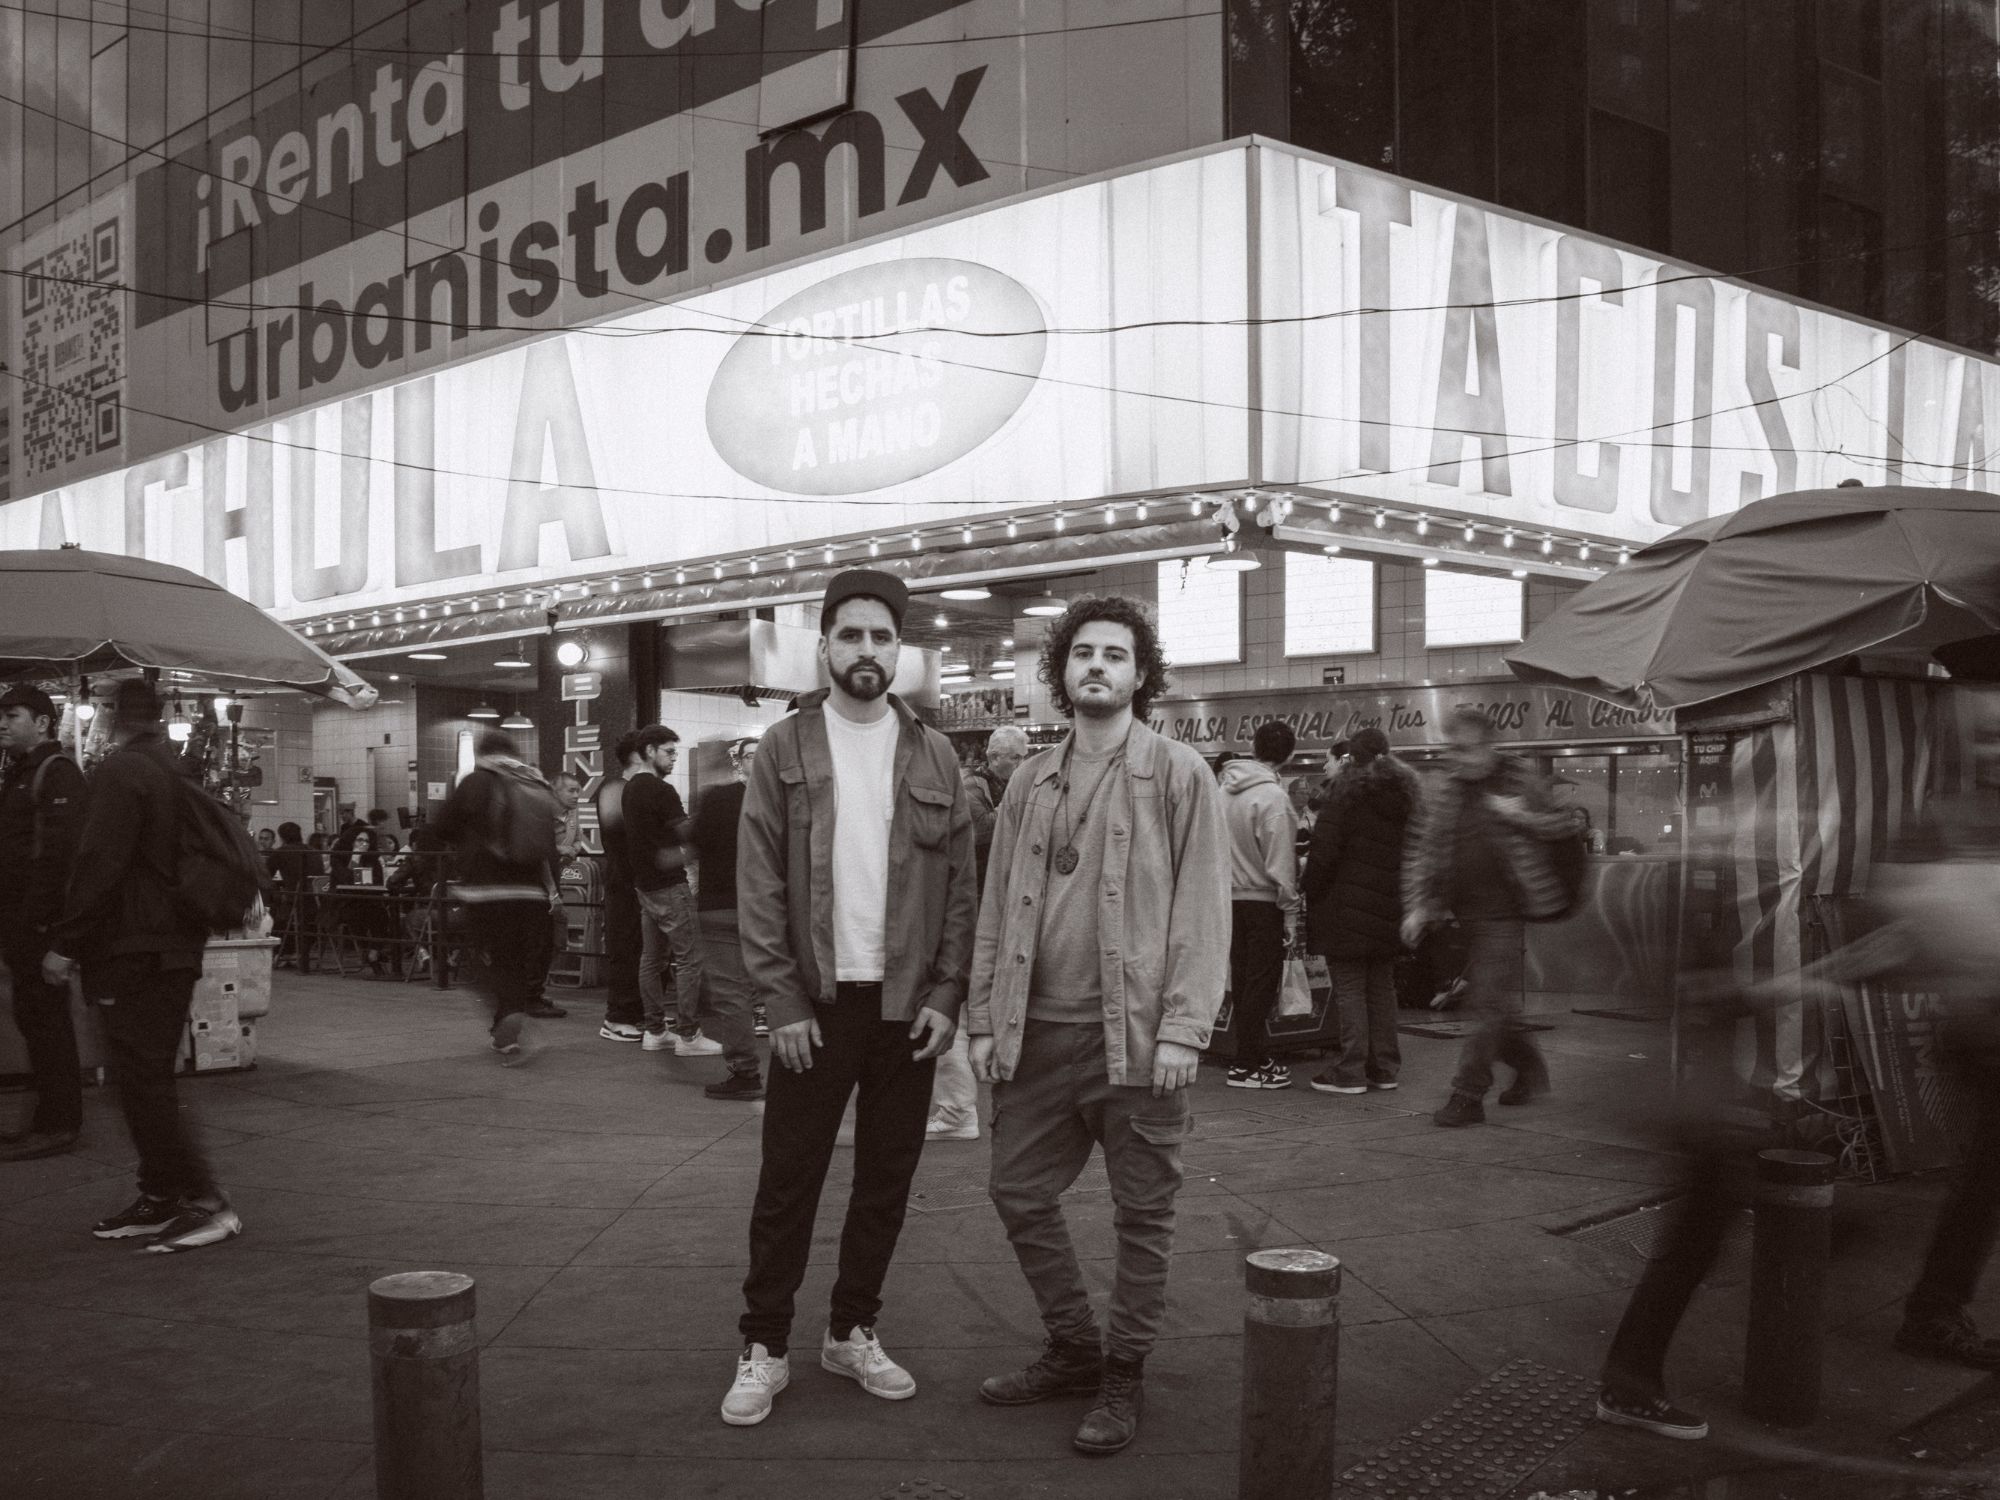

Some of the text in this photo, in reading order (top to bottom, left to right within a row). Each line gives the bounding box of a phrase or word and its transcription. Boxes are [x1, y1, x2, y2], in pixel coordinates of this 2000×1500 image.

[493, 0, 604, 111] tu
[217, 64, 991, 413] urbanista.mx
[764, 274, 972, 366] TORTILLAS
[1333, 166, 1801, 527] TACOS
[790, 341, 944, 417] HECHAS
[124, 337, 612, 609] CHULA
[792, 402, 942, 472] A MANO
[1174, 717, 1228, 743] SALSA
[1235, 711, 1335, 743] ESCIAL
[1456, 702, 1530, 730] COS
[1545, 700, 1575, 727] AL
[1694, 744, 1726, 753] TU CHIP
